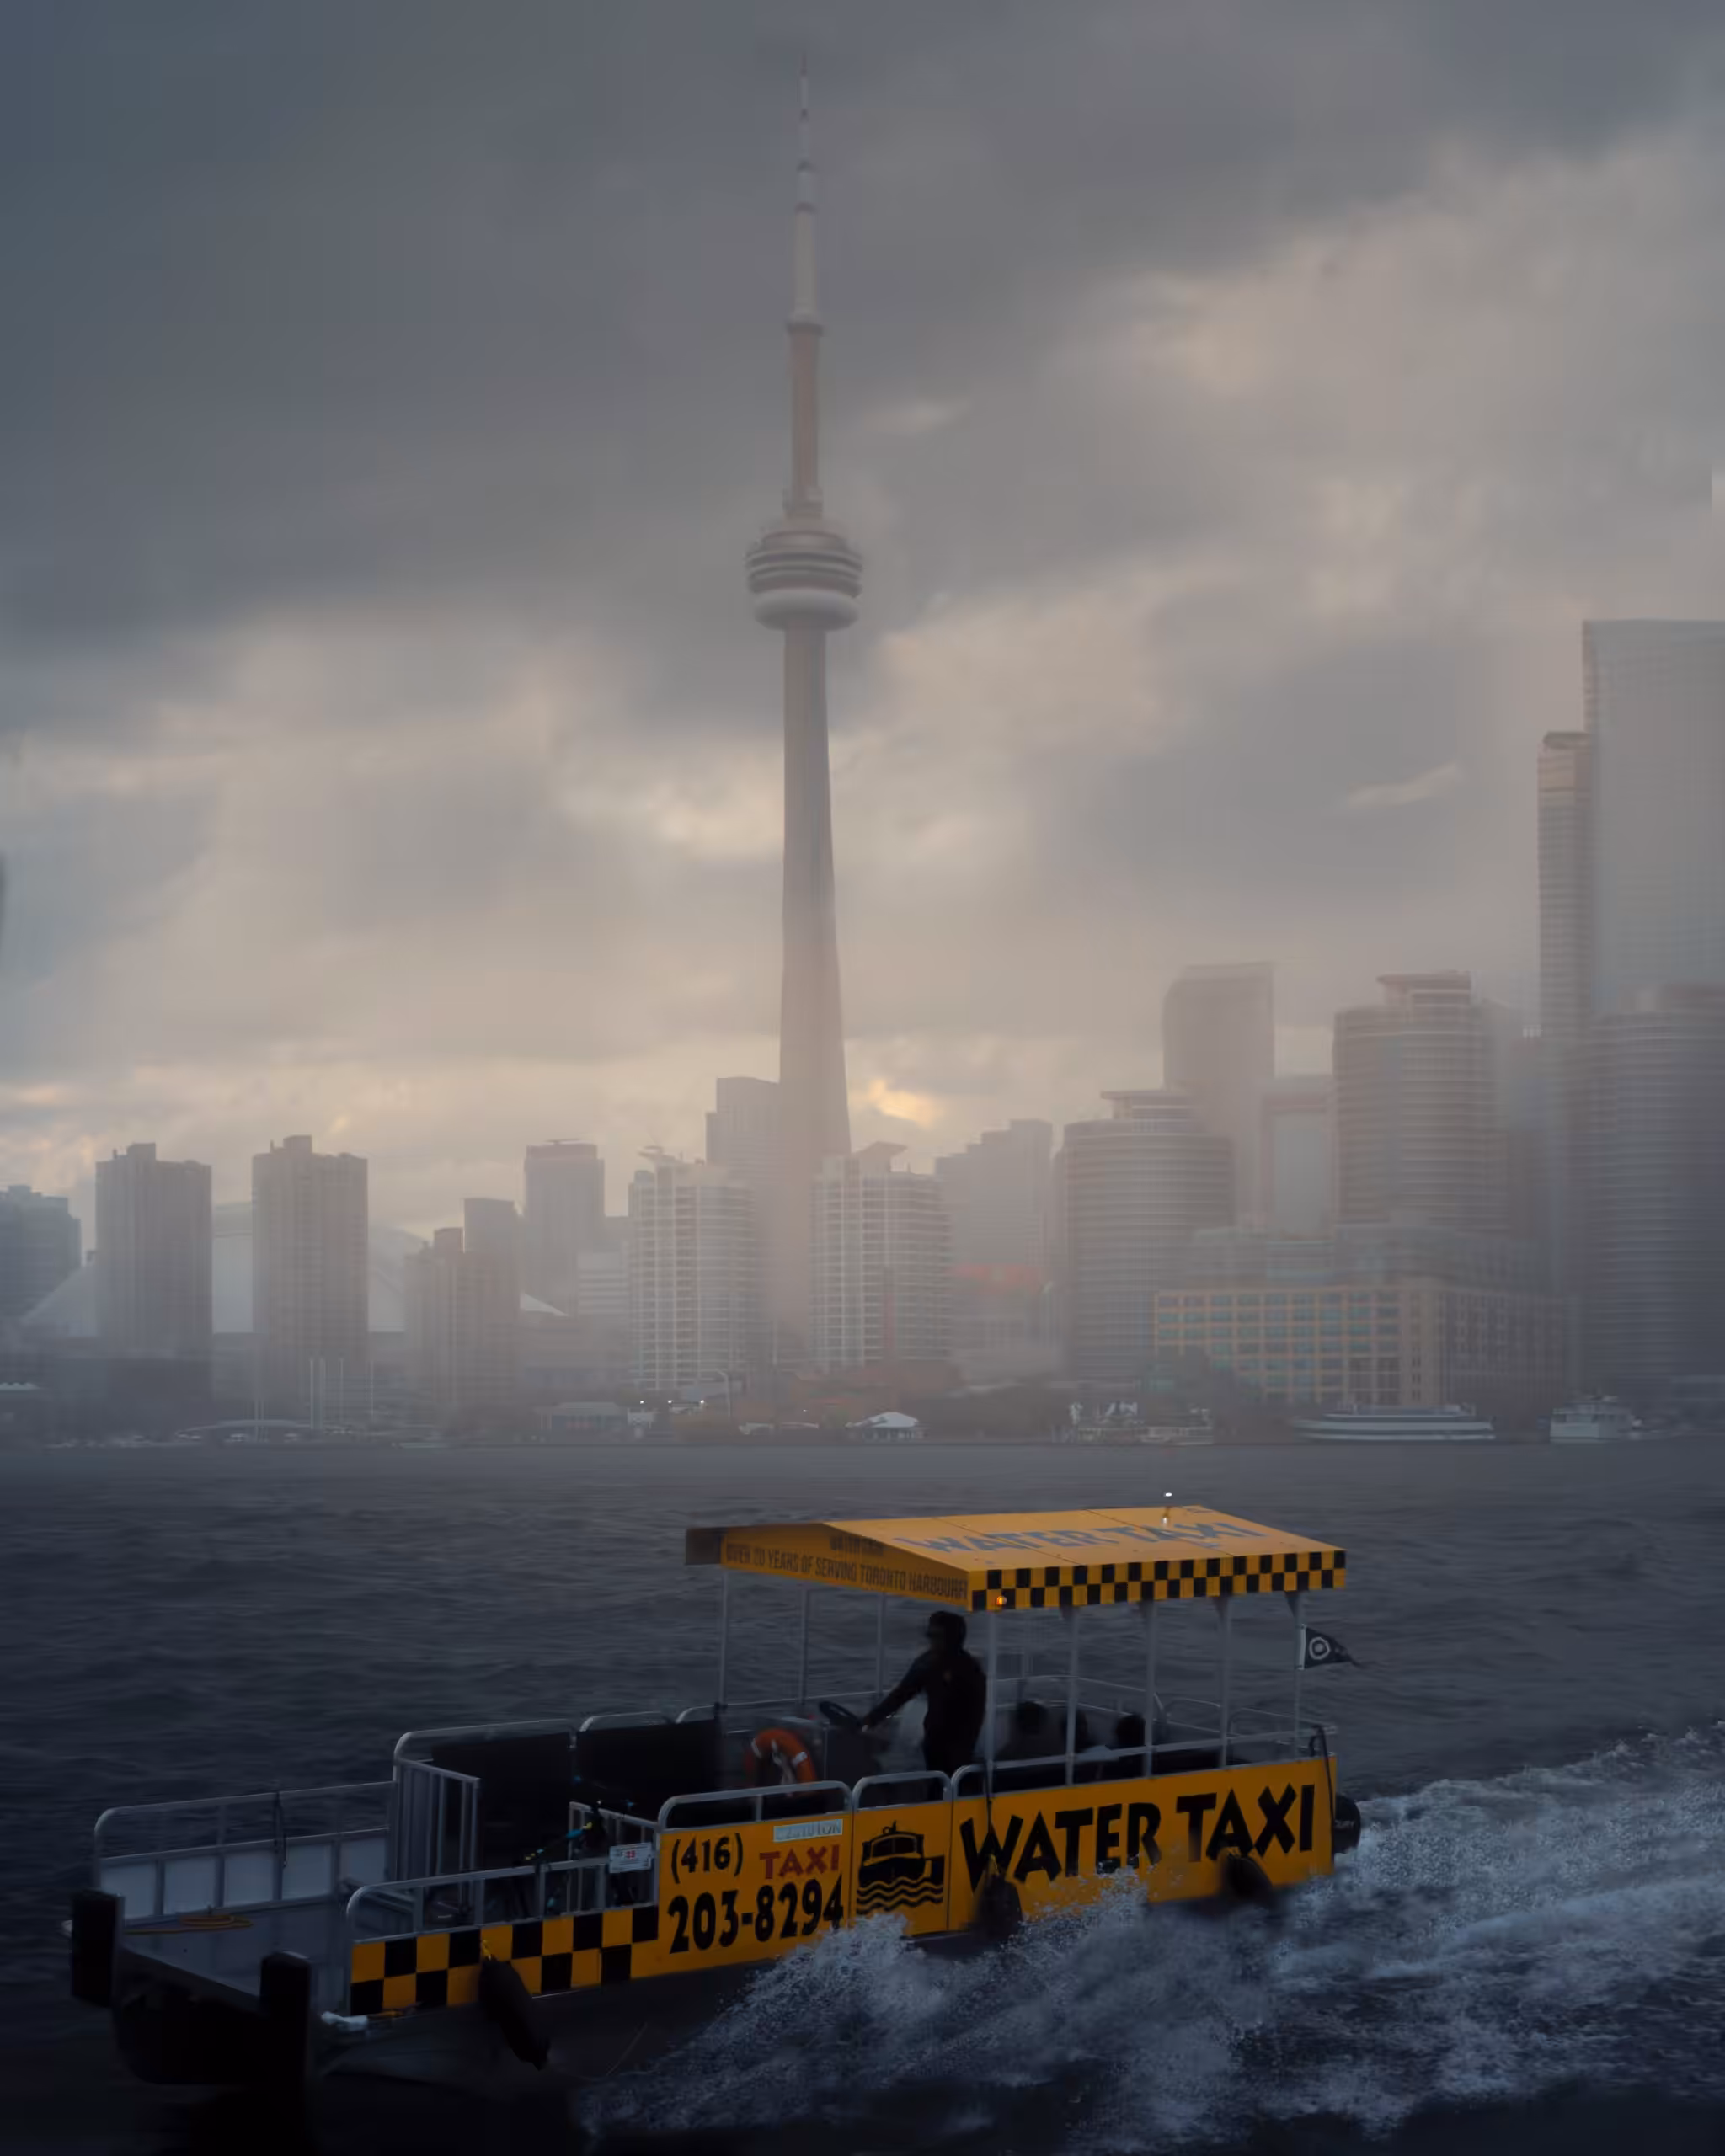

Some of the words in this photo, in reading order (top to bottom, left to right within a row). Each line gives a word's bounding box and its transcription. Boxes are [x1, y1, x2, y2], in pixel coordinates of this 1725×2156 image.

[893, 1528, 1120, 1553] WATER
[1094, 1521, 1269, 1548] TAXI
[767, 1549, 798, 1572] YEARS
[801, 1556, 813, 1574] OF
[814, 1557, 857, 1582] SERVING
[860, 1563, 906, 1591] TORONTO
[671, 1832, 743, 1884] (416)
[760, 1844, 841, 1879] TAXI
[959, 1801, 1162, 1893] WATER
[1177, 1783, 1315, 1863] TAXI
[667, 1874, 843, 1954] 203-8294
